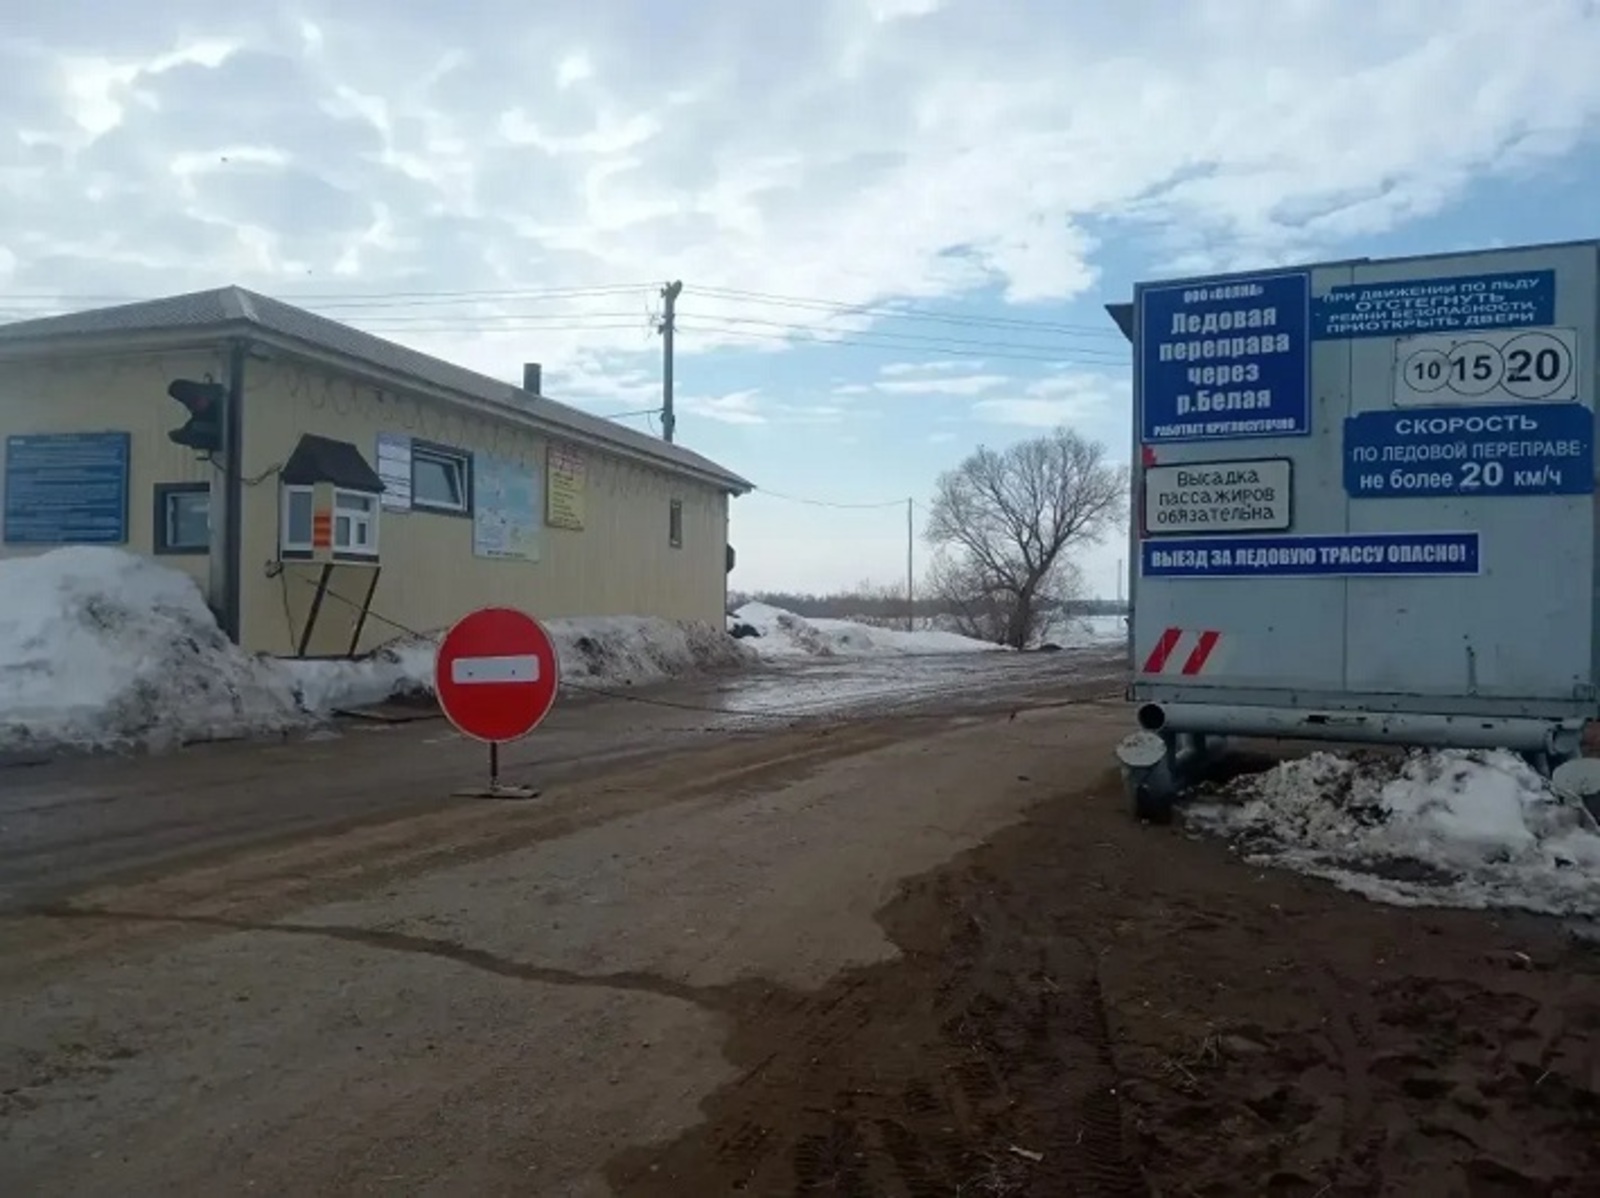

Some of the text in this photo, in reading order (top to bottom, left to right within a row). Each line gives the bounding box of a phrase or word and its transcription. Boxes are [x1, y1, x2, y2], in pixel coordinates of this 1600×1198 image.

[1323, 278, 1541, 303] ПРИ ДВИЖЕНИИ ПО ЛЬДУ
[1355, 292, 1506, 311] ОТСТЕГНУТЬ
[1170, 307, 1277, 335] Ледовая
[1326, 312, 1535, 334] ПРИОТКРЫТЬ ДВЕРИ
[1329, 311, 1388, 323] РЕМНИ
[1159, 333, 1290, 362] переправа
[1187, 363, 1260, 386] через
[1413, 347, 1561, 383] 10 15 20
[1176, 389, 1272, 416] р.Белая
[1153, 423, 1204, 437] РАБОТАЕТ
[1394, 414, 1538, 435] СКОРОСТЬ
[1353, 439, 1581, 463] ПО ЛЕДОВОЙ ПЕРЕПРАВЕ
[1177, 468, 1260, 488] Высадка
[1360, 461, 1562, 489] не более 20 км/ч
[1159, 487, 1276, 506] пассажиров
[1157, 506, 1276, 524] обязательна
[1152, 543, 1467, 569] ВЫЕЗД ЗА ЛЕДОВУЮ ТРАССУ ОПАСНО!
